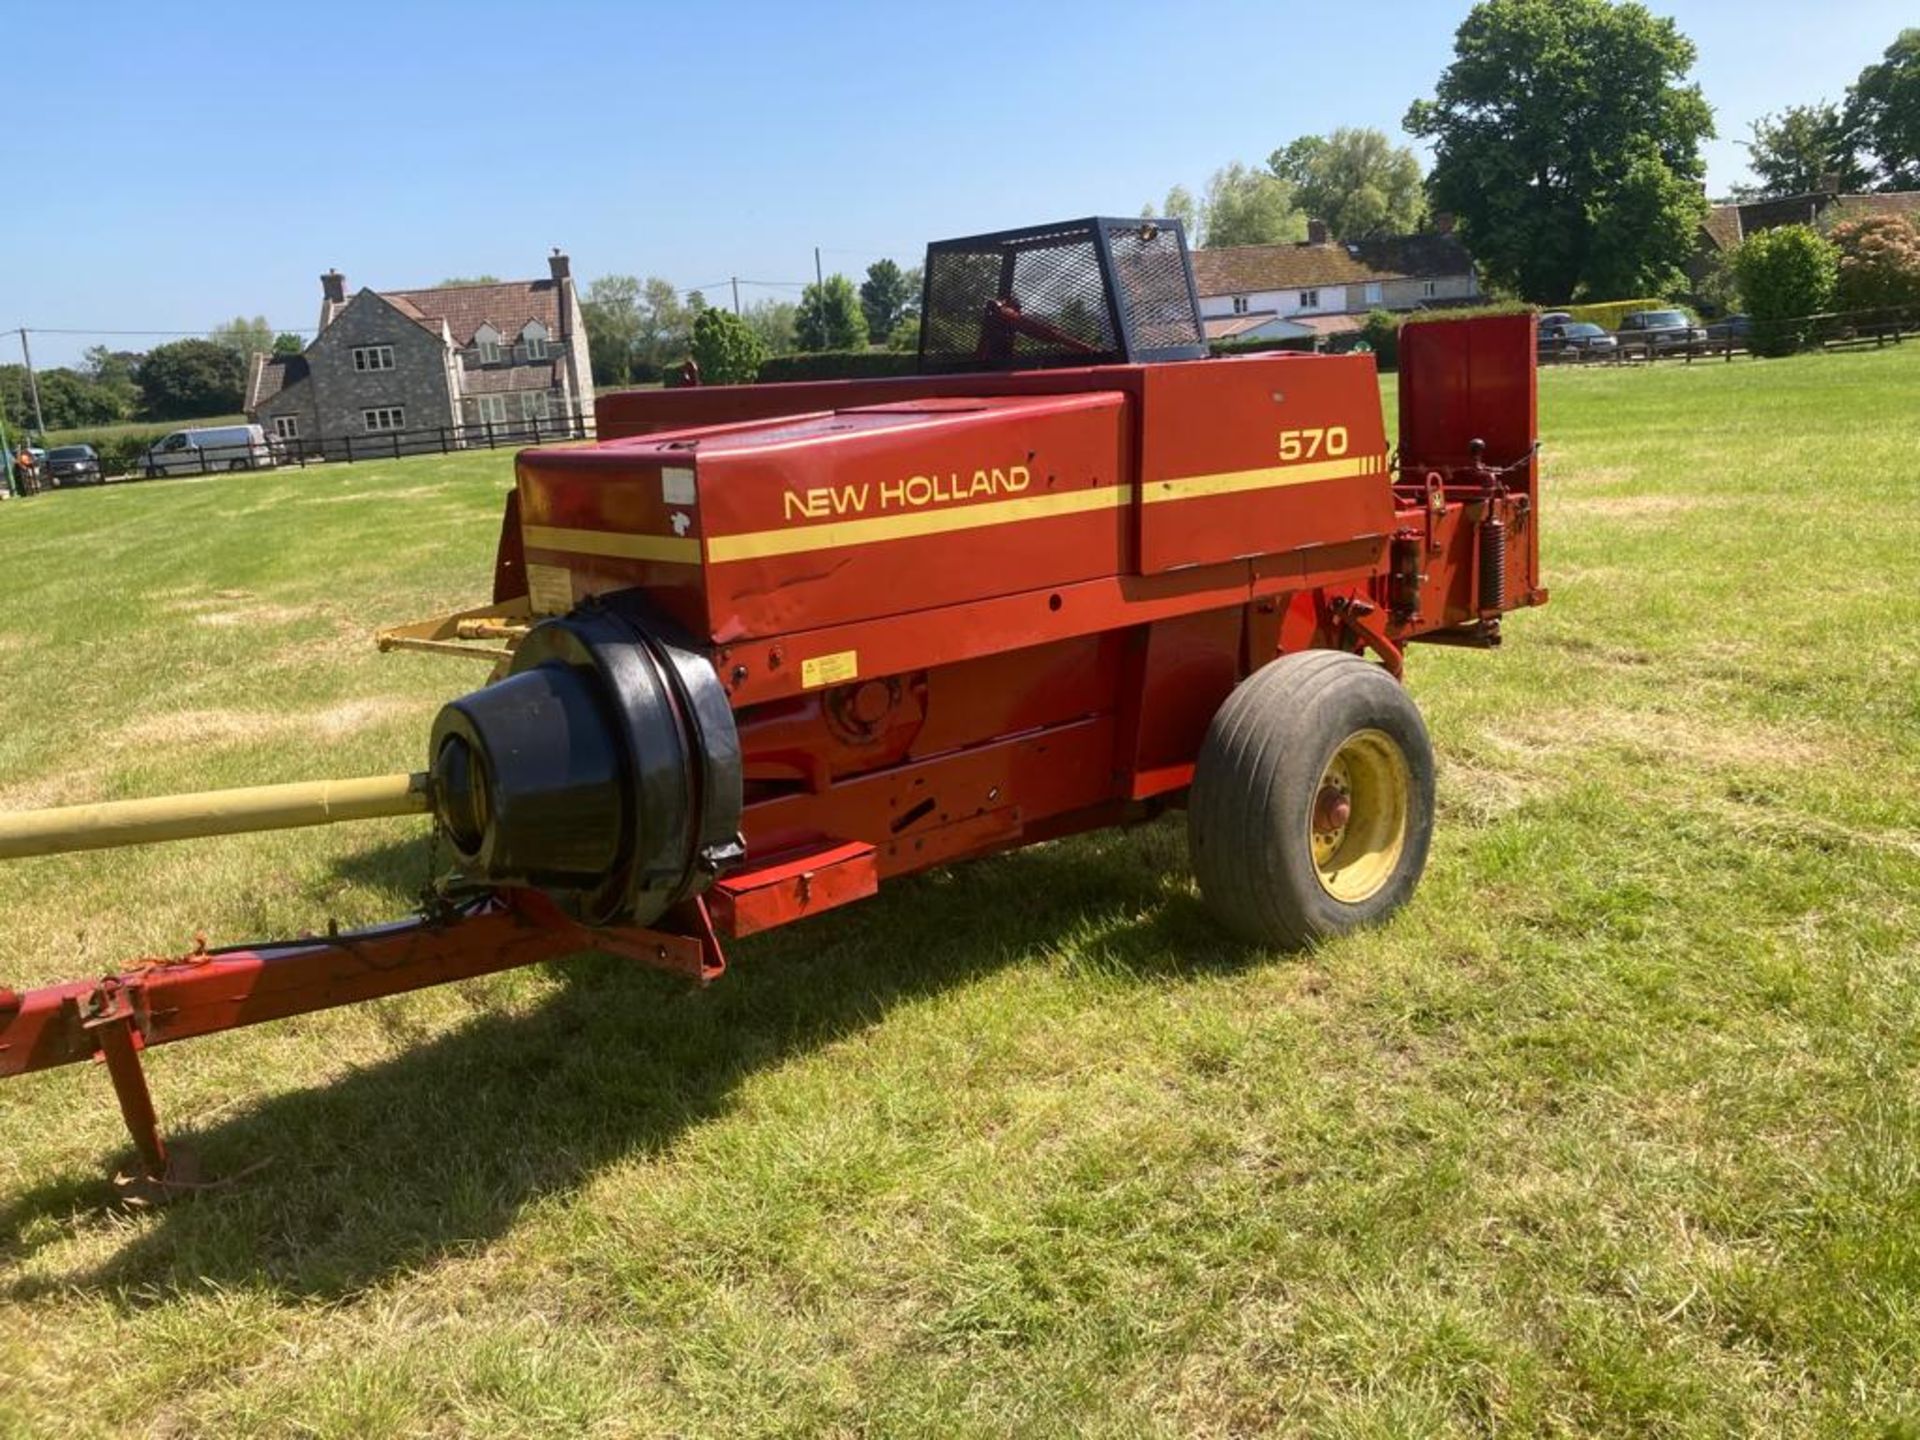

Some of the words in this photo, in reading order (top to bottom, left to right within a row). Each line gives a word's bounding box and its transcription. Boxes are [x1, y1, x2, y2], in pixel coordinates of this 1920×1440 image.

[1279, 426, 1348, 460] 570
[784, 484, 868, 519] NEW
[880, 466, 1030, 509] HOLLAND
